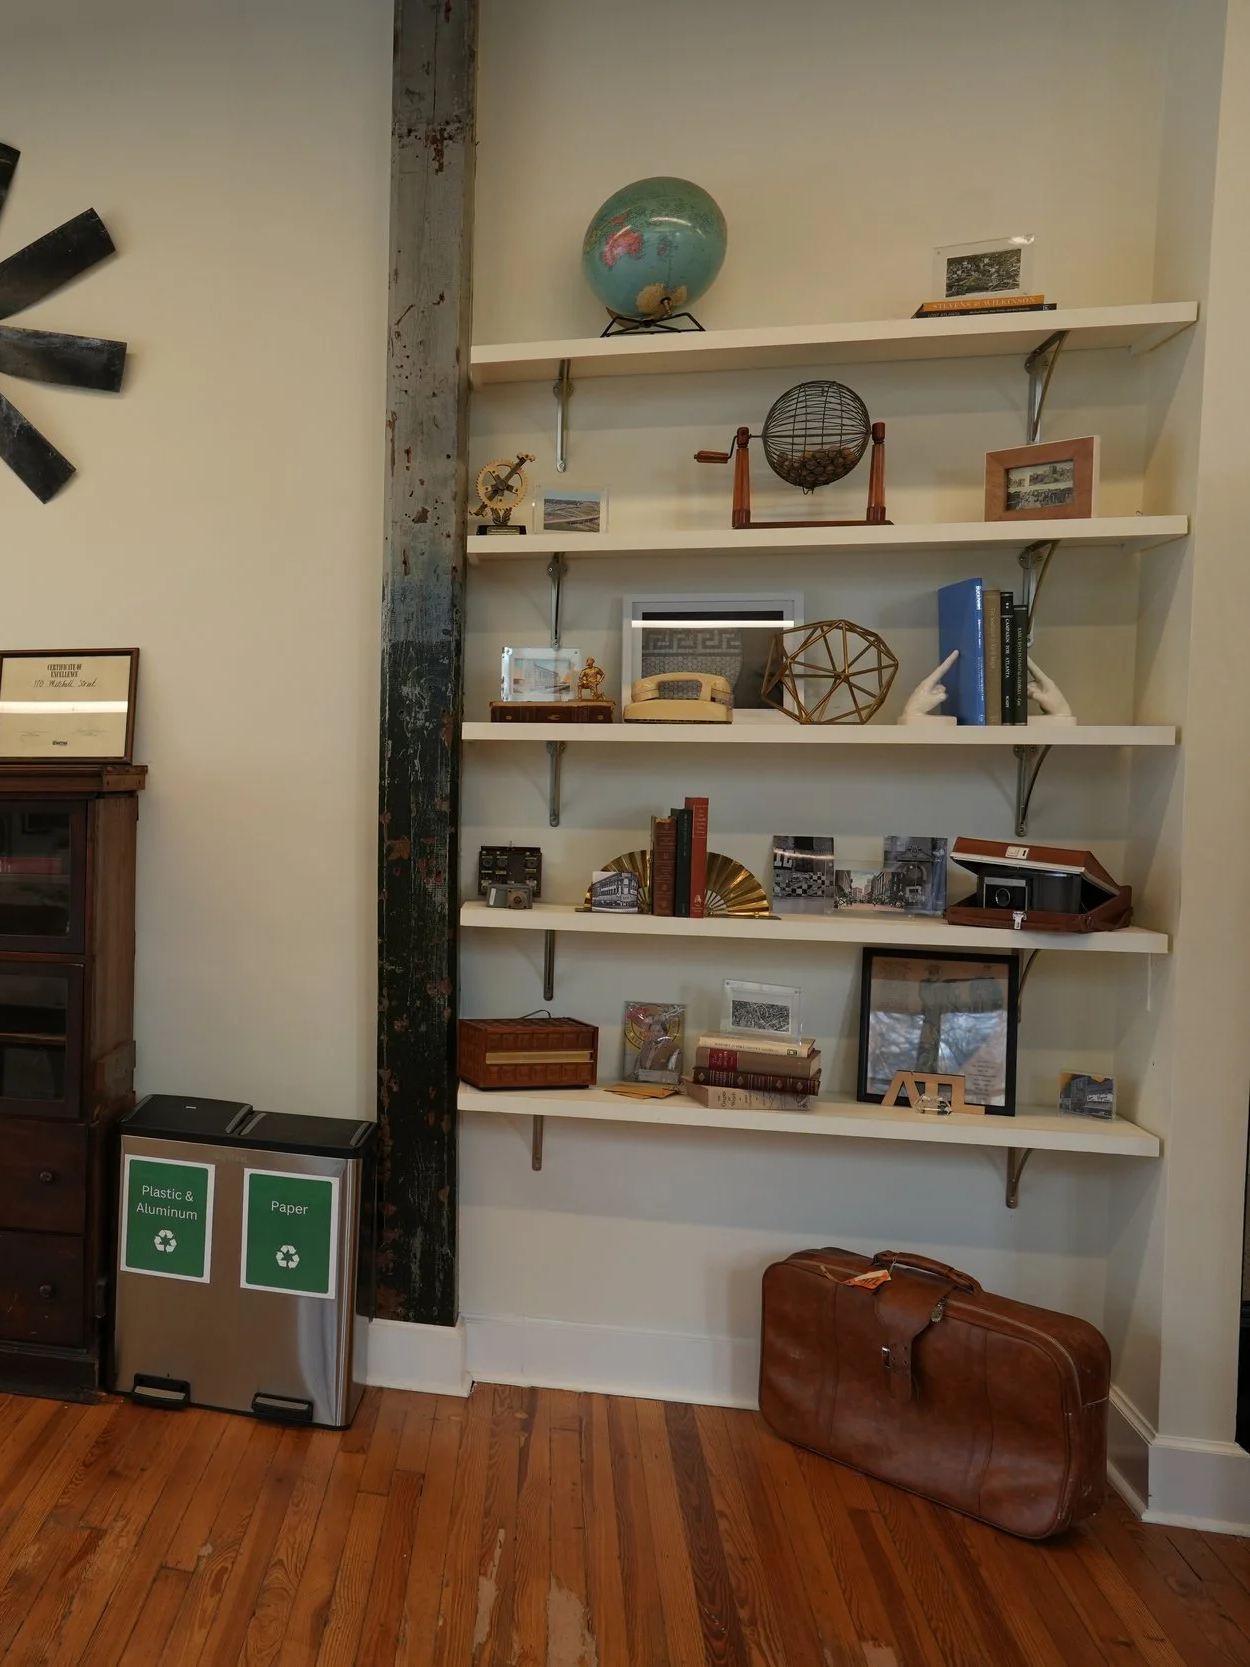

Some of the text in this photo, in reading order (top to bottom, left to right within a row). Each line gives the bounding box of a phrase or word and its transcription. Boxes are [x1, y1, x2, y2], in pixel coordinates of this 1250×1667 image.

[933, 302, 970, 310] STEVENS
[984, 296, 1036, 306] WILKINSON
[47, 663, 76, 671] CERTIFICATE
[50, 670, 78, 678] EXCELLENCE
[48, 679, 75, 688] Mitchell
[78, 677, 97, 688] Street
[881, 1070, 985, 1115] ATL
[142, 1185, 194, 1202] Plastic &
[136, 1202, 198, 1221] Aluminum
[271, 1200, 309, 1216] Paper
